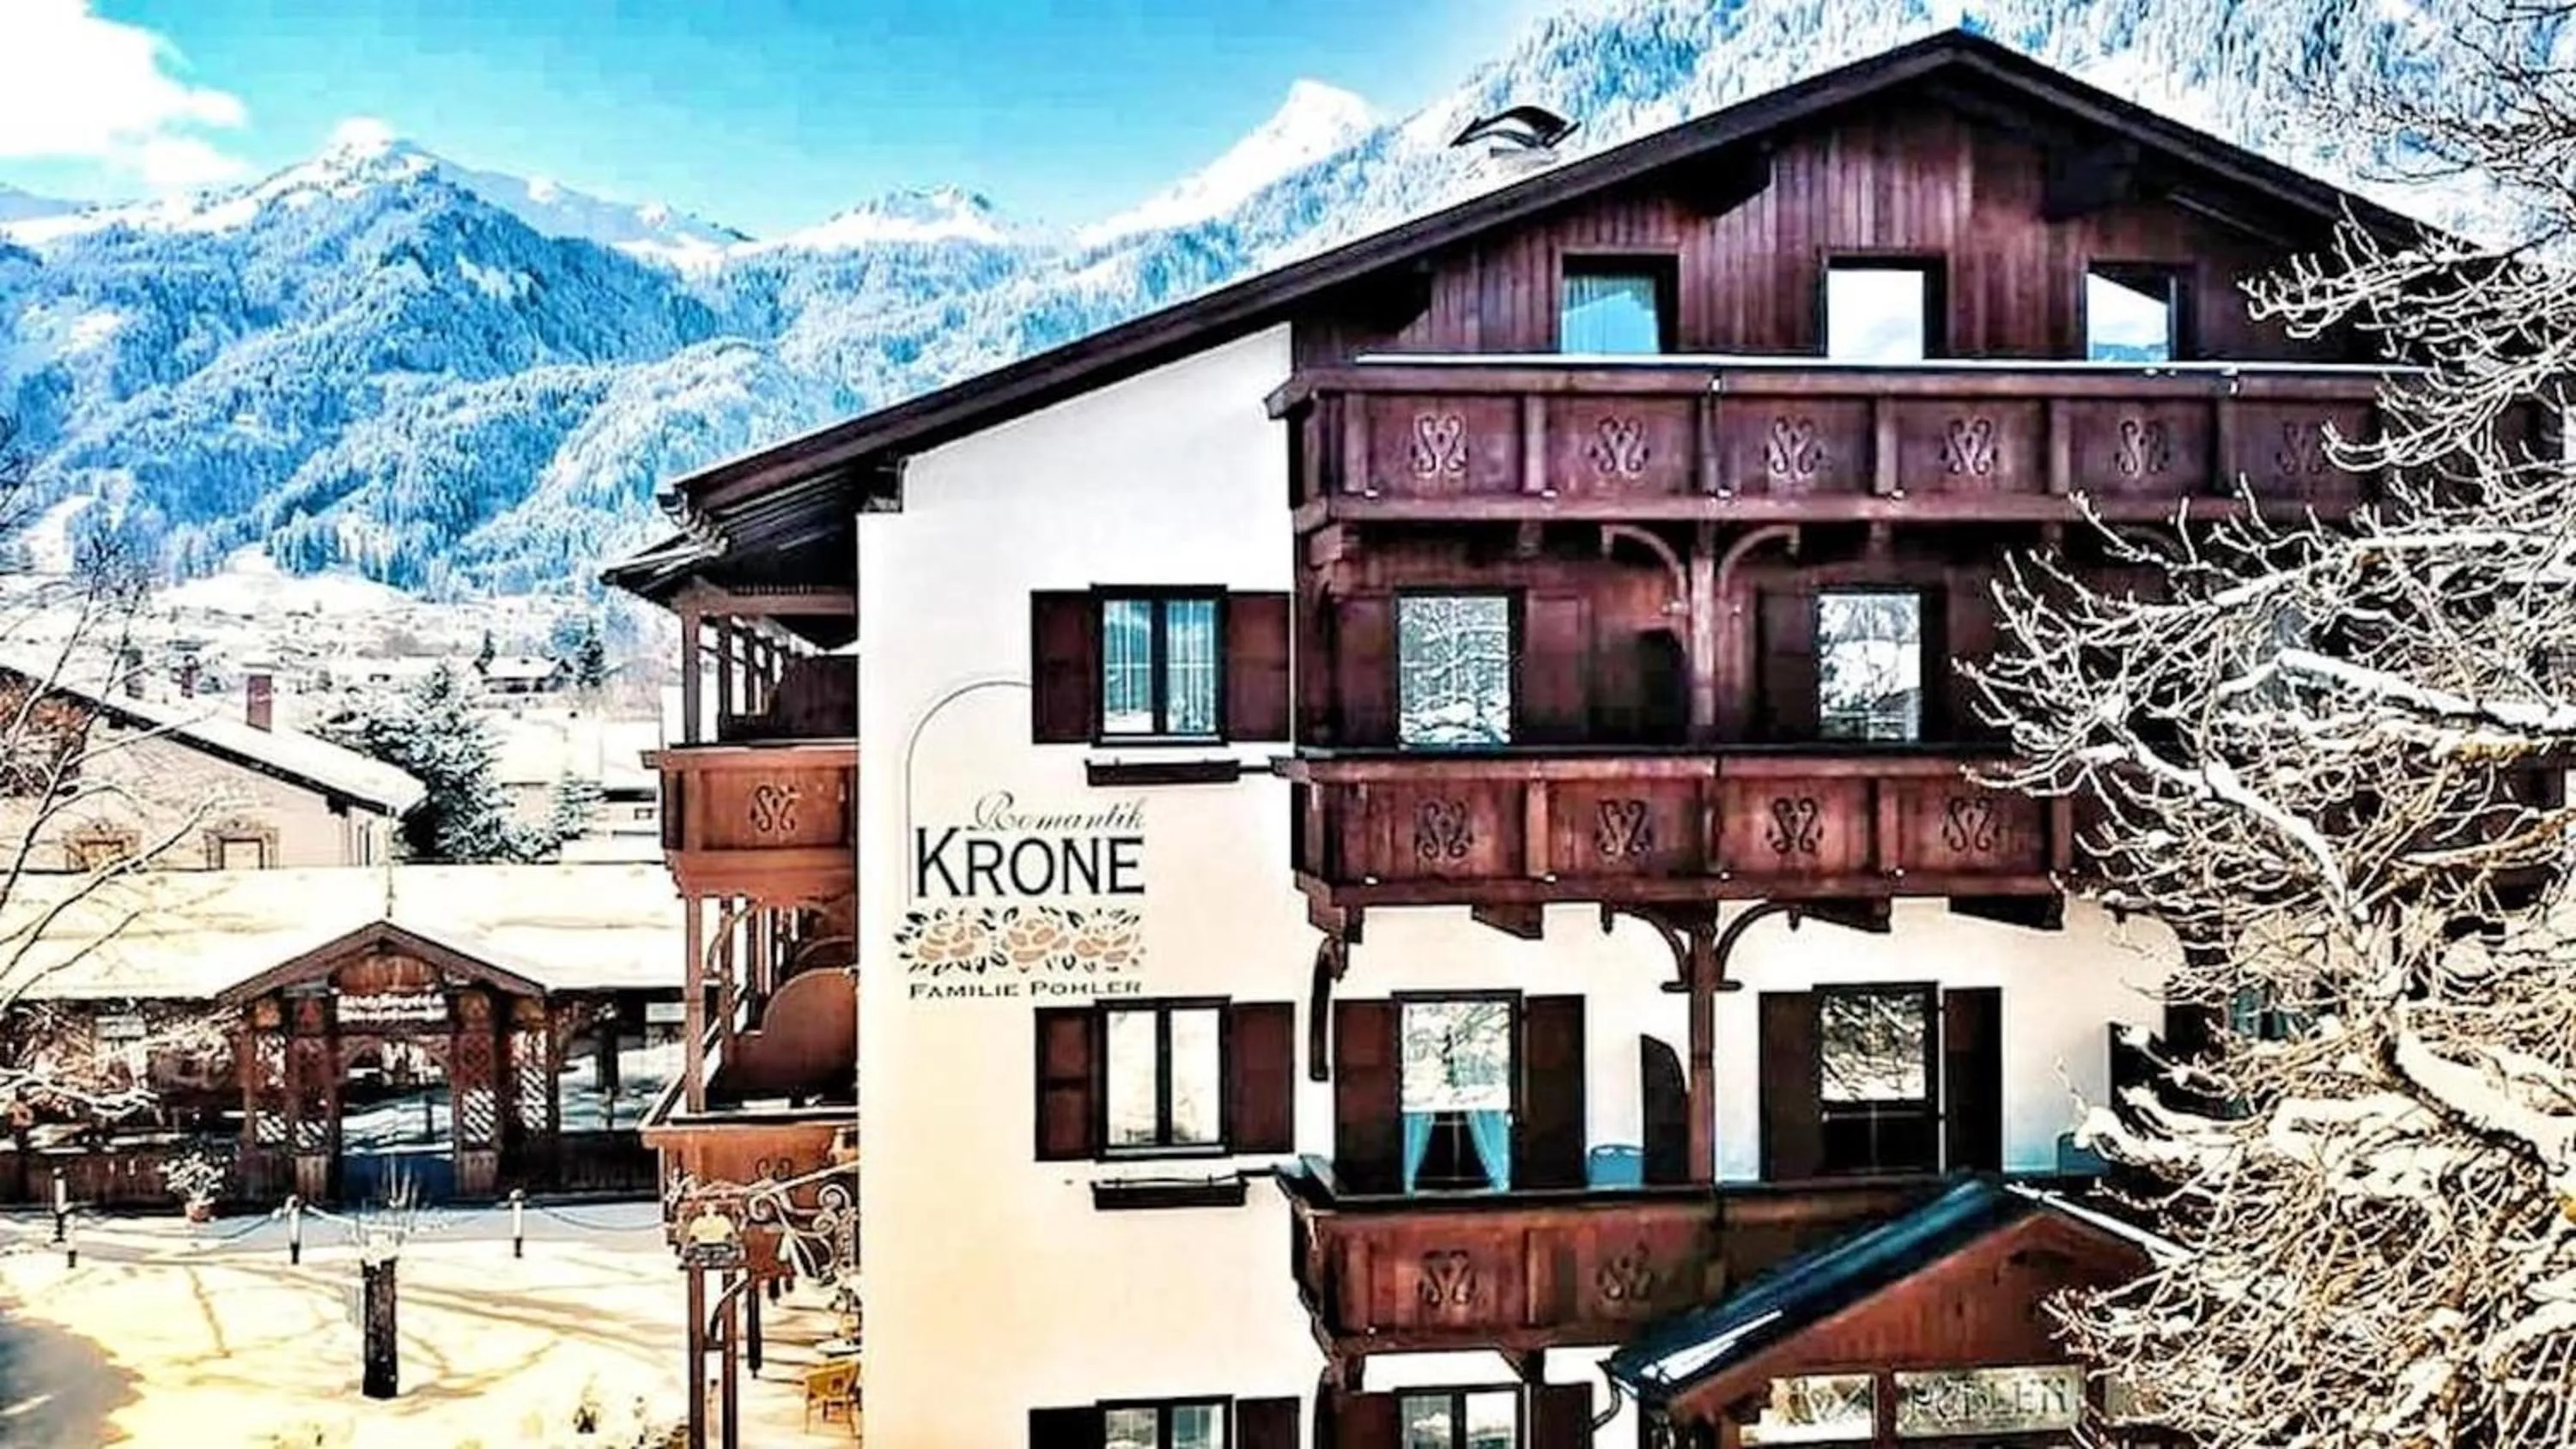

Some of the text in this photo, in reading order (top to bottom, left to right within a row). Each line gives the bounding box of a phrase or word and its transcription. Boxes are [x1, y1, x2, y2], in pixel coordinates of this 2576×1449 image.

[966, 790, 1148, 832] Romantik
[916, 826, 1145, 897] KRONE
[908, 979, 1143, 999] FAMILIE POHLER
